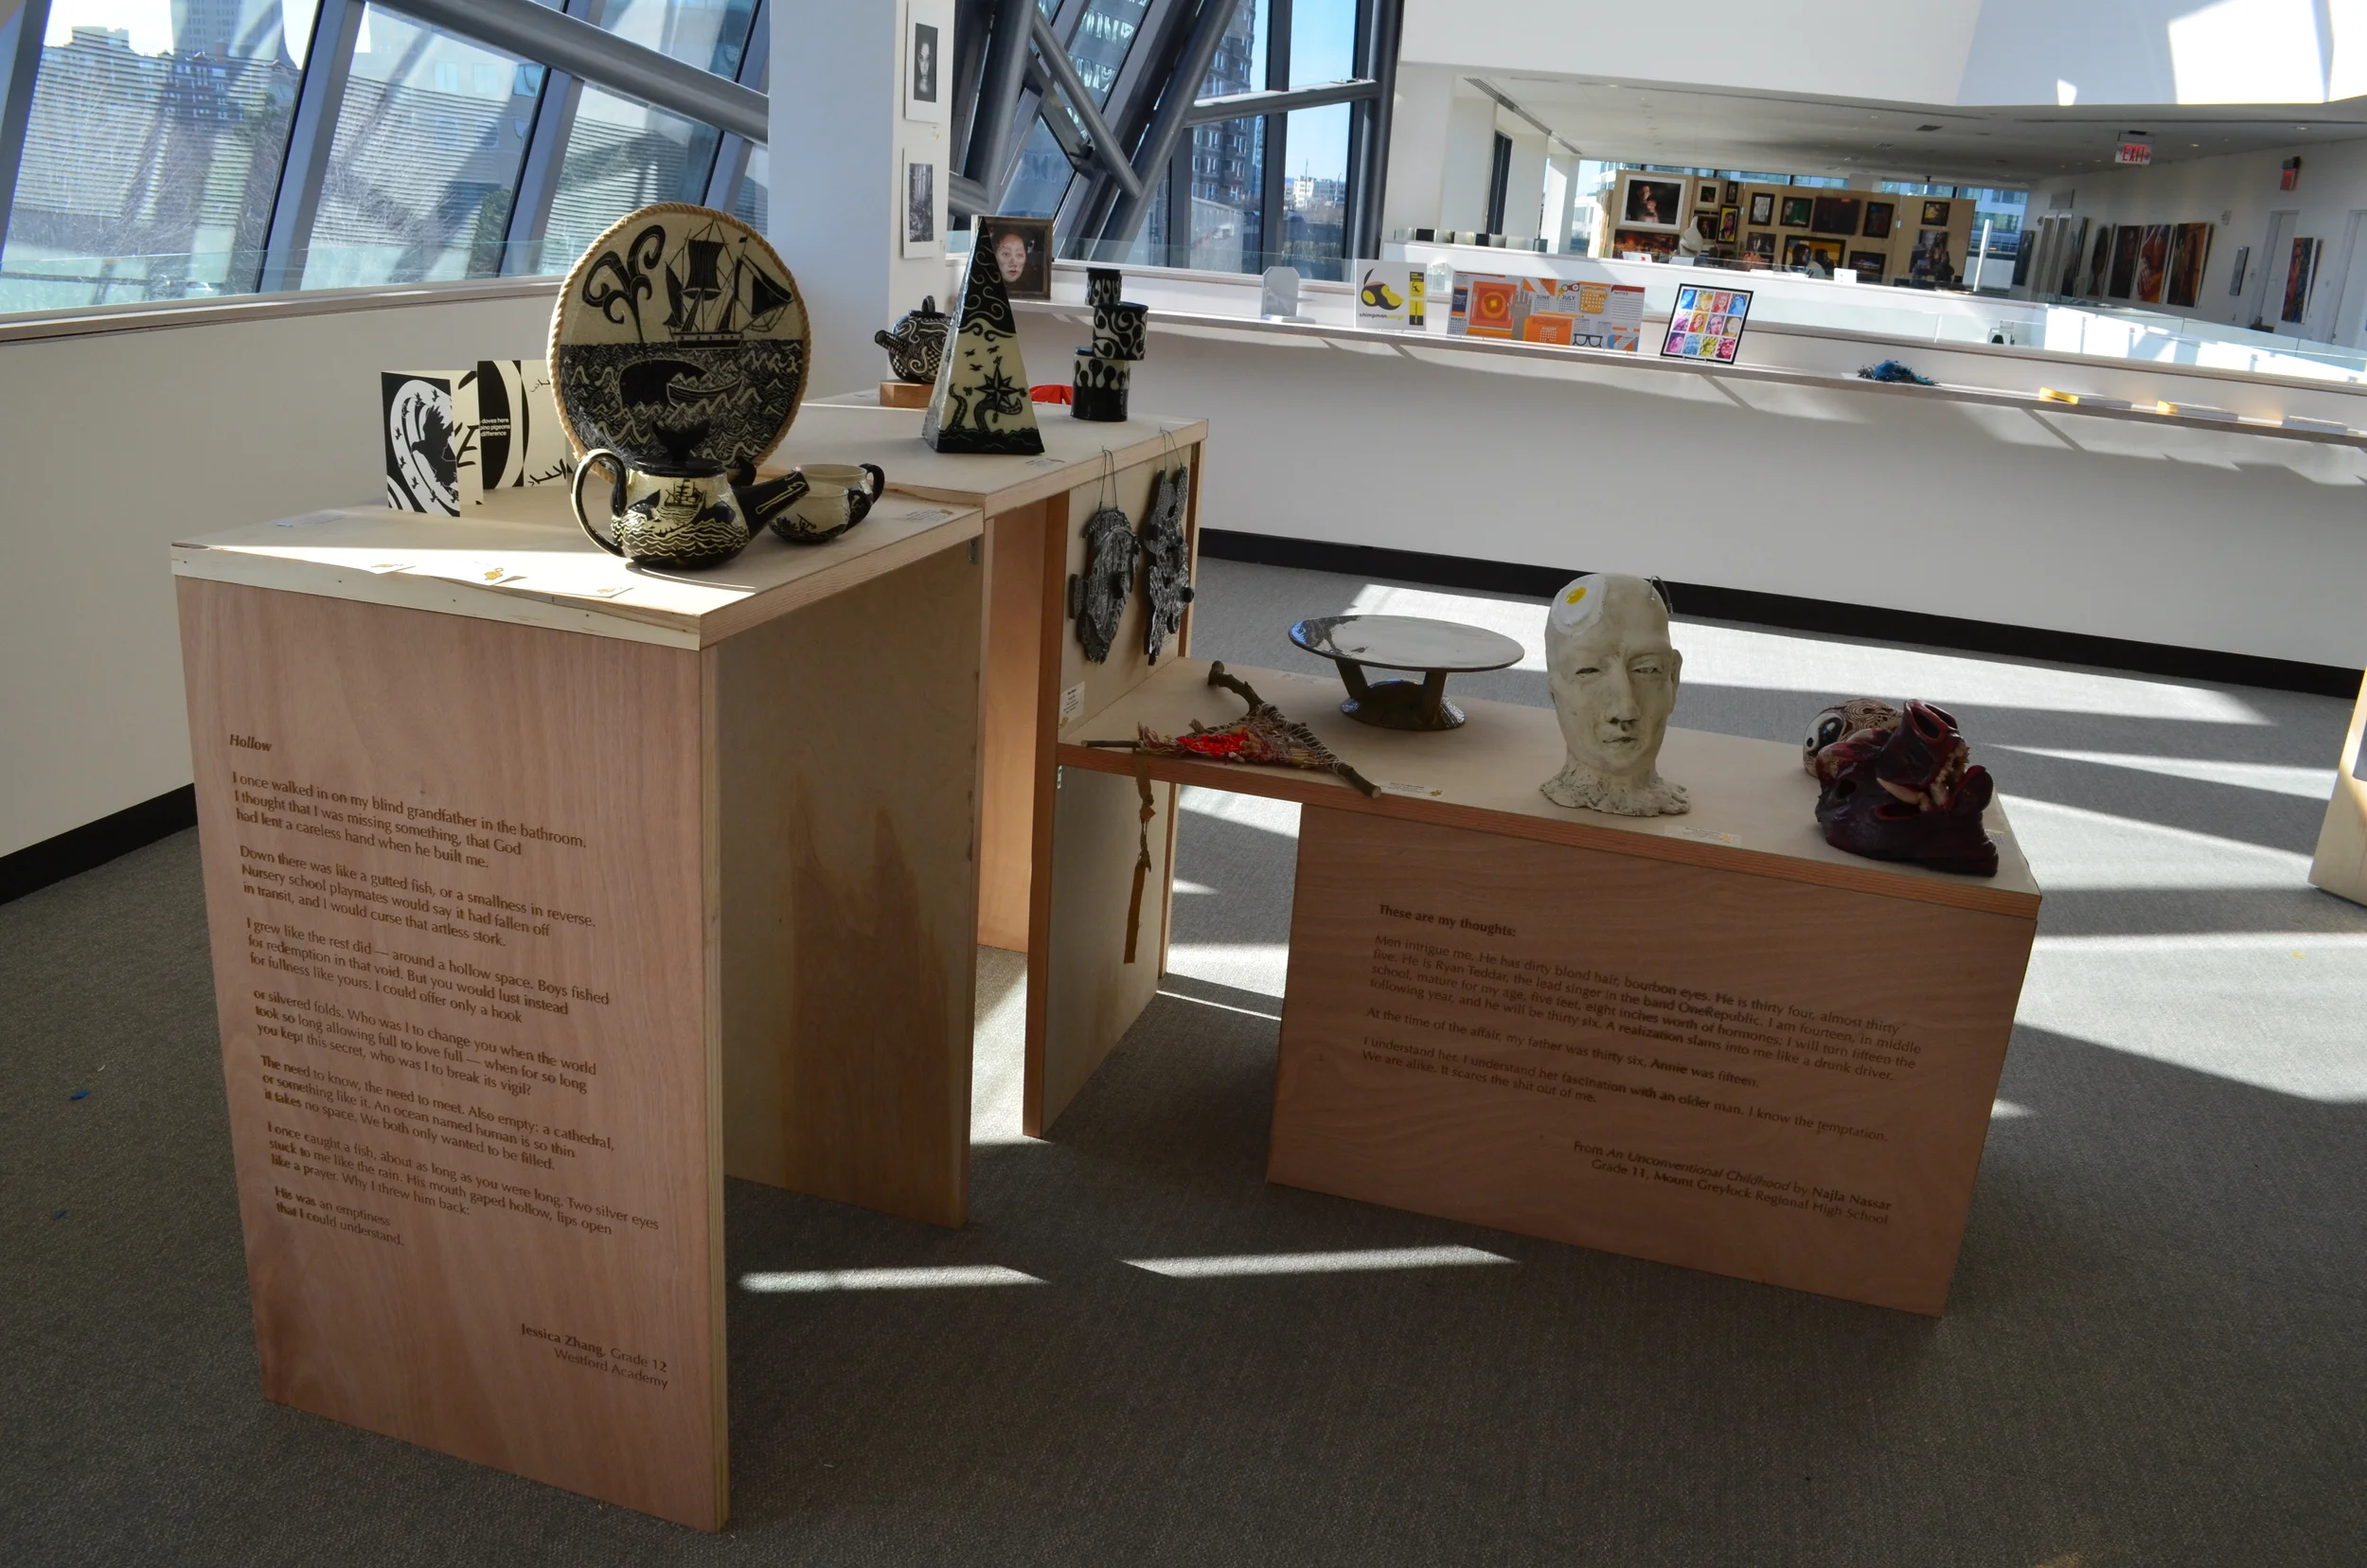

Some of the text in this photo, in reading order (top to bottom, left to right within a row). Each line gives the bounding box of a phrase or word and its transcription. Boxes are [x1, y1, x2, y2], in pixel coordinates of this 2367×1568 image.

[2122, 143, 2147, 162] EXIT
[228, 733, 272, 752] Hollow
[231, 770, 587, 848] I once walked in on my blind grandfather in the bathroom.
[234, 789, 522, 856] I thought that I was missing something, that God
[235, 807, 489, 868] had lent a careless hand when he built me.
[239, 844, 596, 928] Down there was like a gutted fish, or a smallness in reverse.
[1379, 903, 1412, 919] These
[1414, 912, 1434, 923] are
[1437, 916, 1456, 929] my
[1374, 934, 1401, 948] Men
[1404, 938, 1450, 957] intrigue
[1478, 952, 1497, 965] He
[1500, 954, 1521, 969] has
[1523, 959, 1552, 976] dirty
[1554, 964, 1591, 981] blond
[1624, 975, 1677, 995] bourbon
[1715, 991, 1735, 1006] He
[1737, 996, 1748, 1007] is
[1751, 998, 1784, 1016] thirty
[1819, 1010, 1862, 1027] almost
[1865, 1018, 1900, 1037] thirty
[256, 1023, 531, 1097] you kept this secret, who was I to break its vigil?
[1361, 1049, 1381, 1062] We
[1384, 1056, 1402, 1067] are
[1440, 1064, 1449, 1076] It
[1451, 1068, 1487, 1082] scares
[1490, 1074, 1509, 1087] the
[1512, 1078, 1533, 1092] shit
[1536, 1084, 1557, 1096] out
[1558, 1087, 1573, 1098] of
[1365, 1007, 1379, 1019] At
[1382, 1009, 1401, 1022] the
[1404, 1014, 1431, 1027] time
[1433, 1020, 1446, 1030] of
[1448, 1021, 1468, 1035] the
[1505, 1034, 1524, 1047] my
[1527, 1036, 1563, 1051] father
[1565, 1044, 1589, 1057] was
[1592, 1047, 1624, 1065] thirty
[1649, 1058, 1688, 1075] Annie
[1690, 1067, 1714, 1079] was
[263, 1087, 555, 1170] it takes no space. We both only wanted to be filled.
[274, 1185, 391, 1226] His was an emptiness
[1573, 1140, 1892, 1210] From An Unconventional Childhood by Najla Nassar
[1591, 1158, 1628, 1175] Grade
[1653, 1170, 1693, 1187] Mount
[1696, 1179, 1751, 1199] Greylock
[1754, 1190, 1809, 1209] Regional
[1812, 1202, 1842, 1218] High
[1846, 1207, 1888, 1225] School
[276, 1201, 404, 1246] that I could understand.
[521, 1322, 667, 1373] Jessica Zhang, Grade 12
[553, 1346, 668, 1391] Westford Academy
